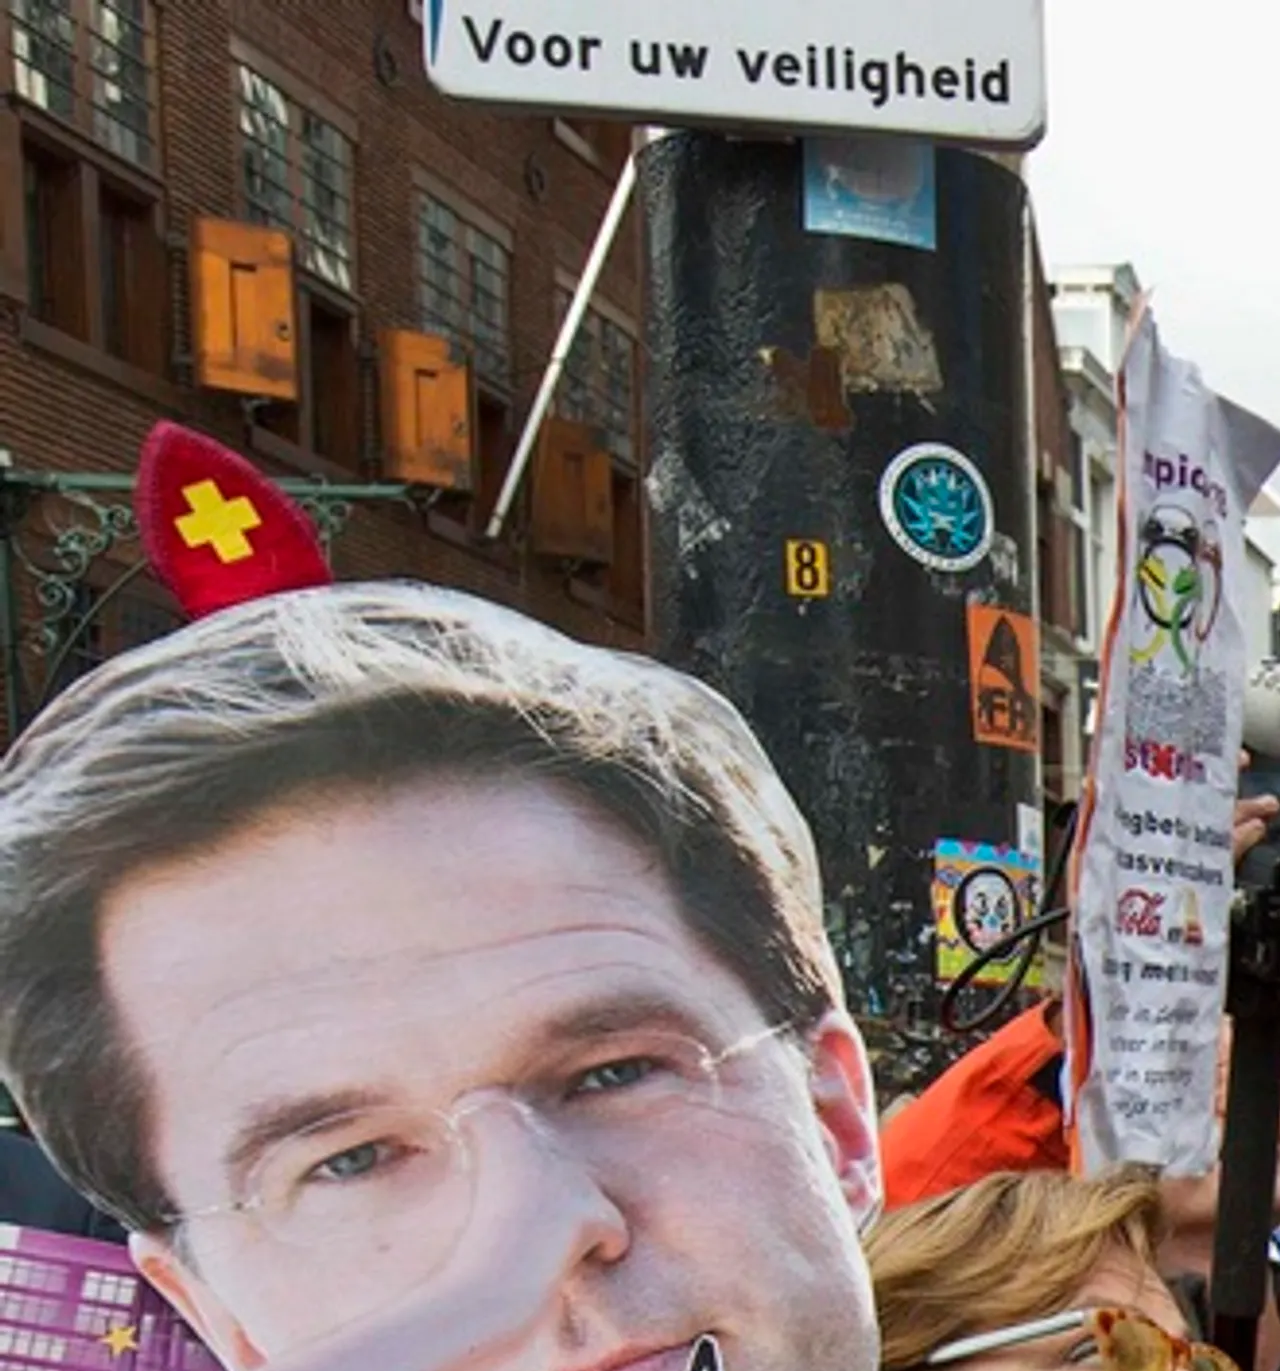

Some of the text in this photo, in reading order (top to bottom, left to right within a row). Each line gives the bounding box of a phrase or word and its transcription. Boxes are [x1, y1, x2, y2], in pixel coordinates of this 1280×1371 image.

[461, 16, 1009, 107] Voor uw veiligheid
[796, 542, 819, 590] 8
